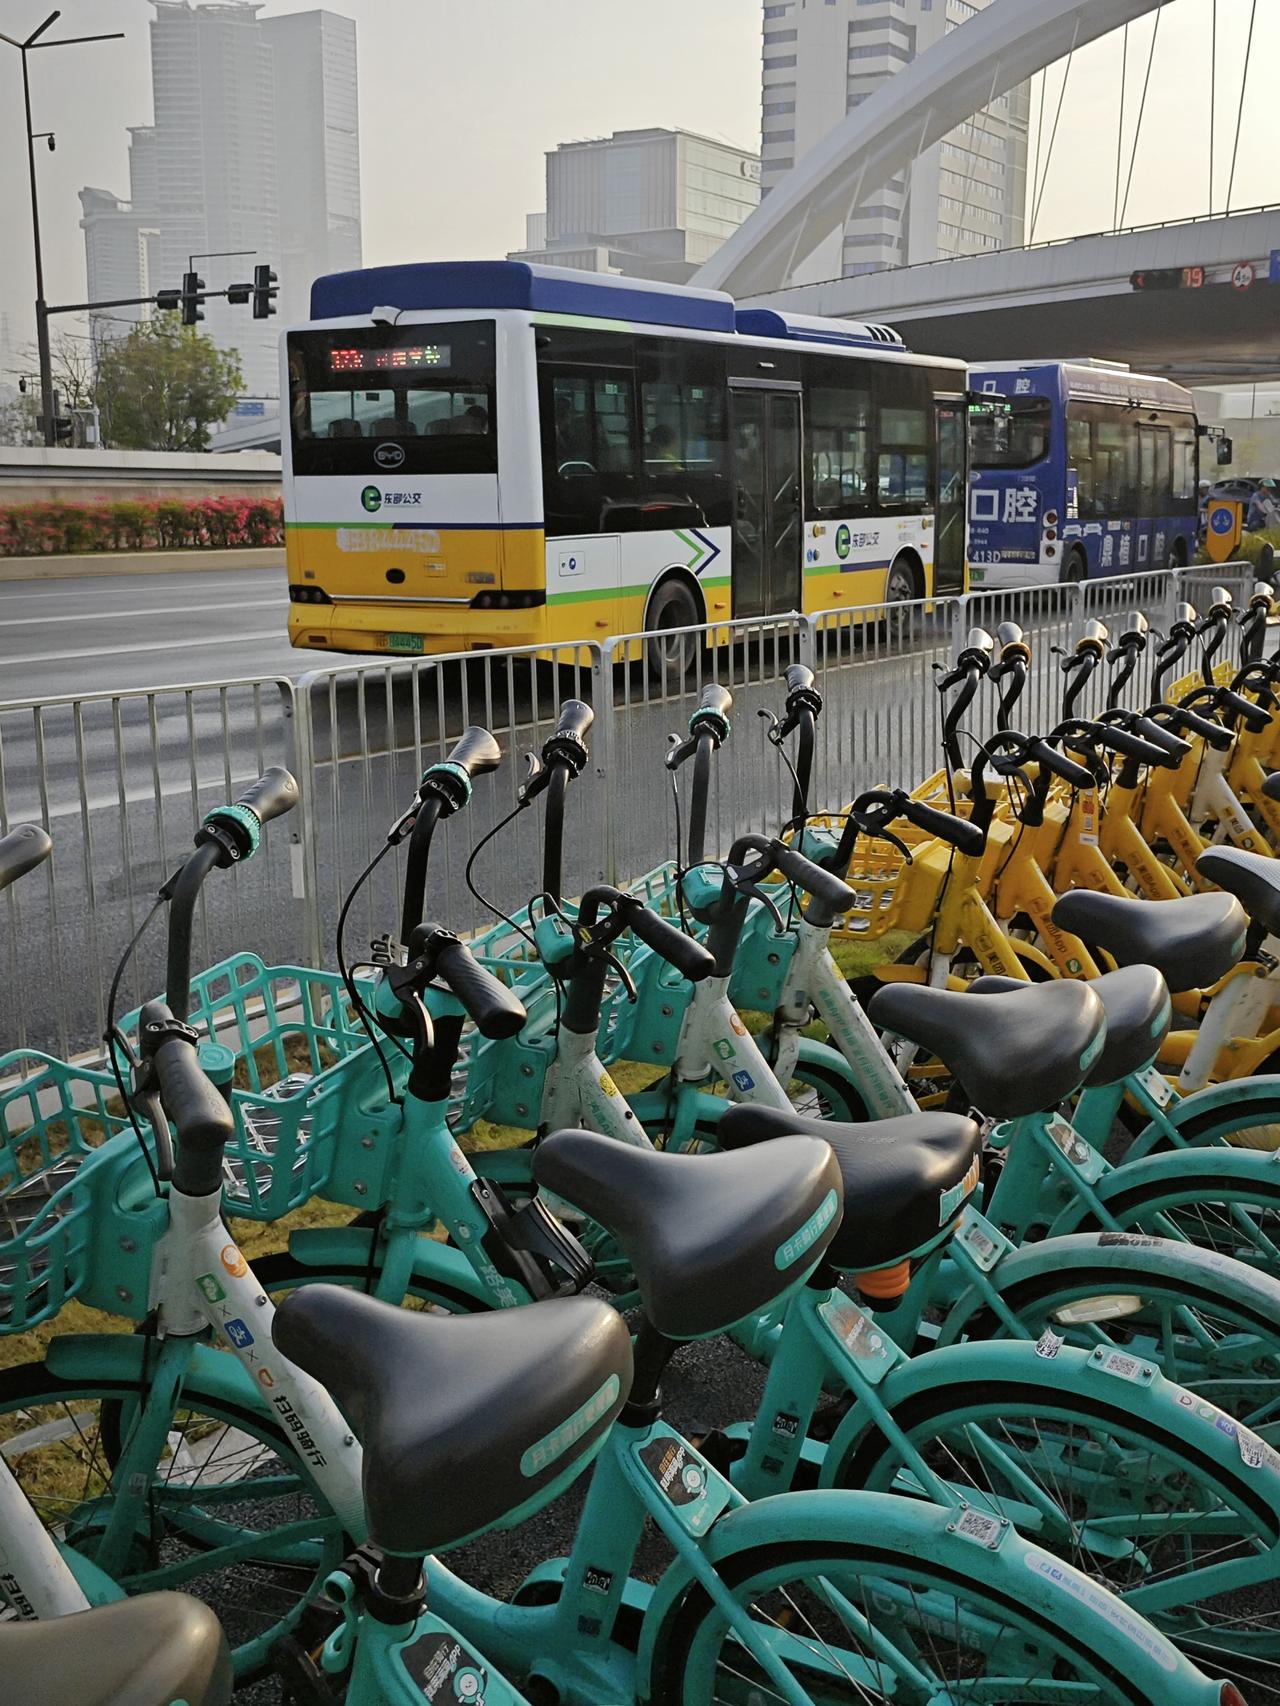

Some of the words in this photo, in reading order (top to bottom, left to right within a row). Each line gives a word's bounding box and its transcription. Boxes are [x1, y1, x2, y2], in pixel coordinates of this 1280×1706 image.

[378, 451, 402, 460] BYD
[384, 493, 422, 504] 东部公交
[971, 487, 1037, 523] 口腔
[273, 1395, 328, 1467] 扫码骑行
